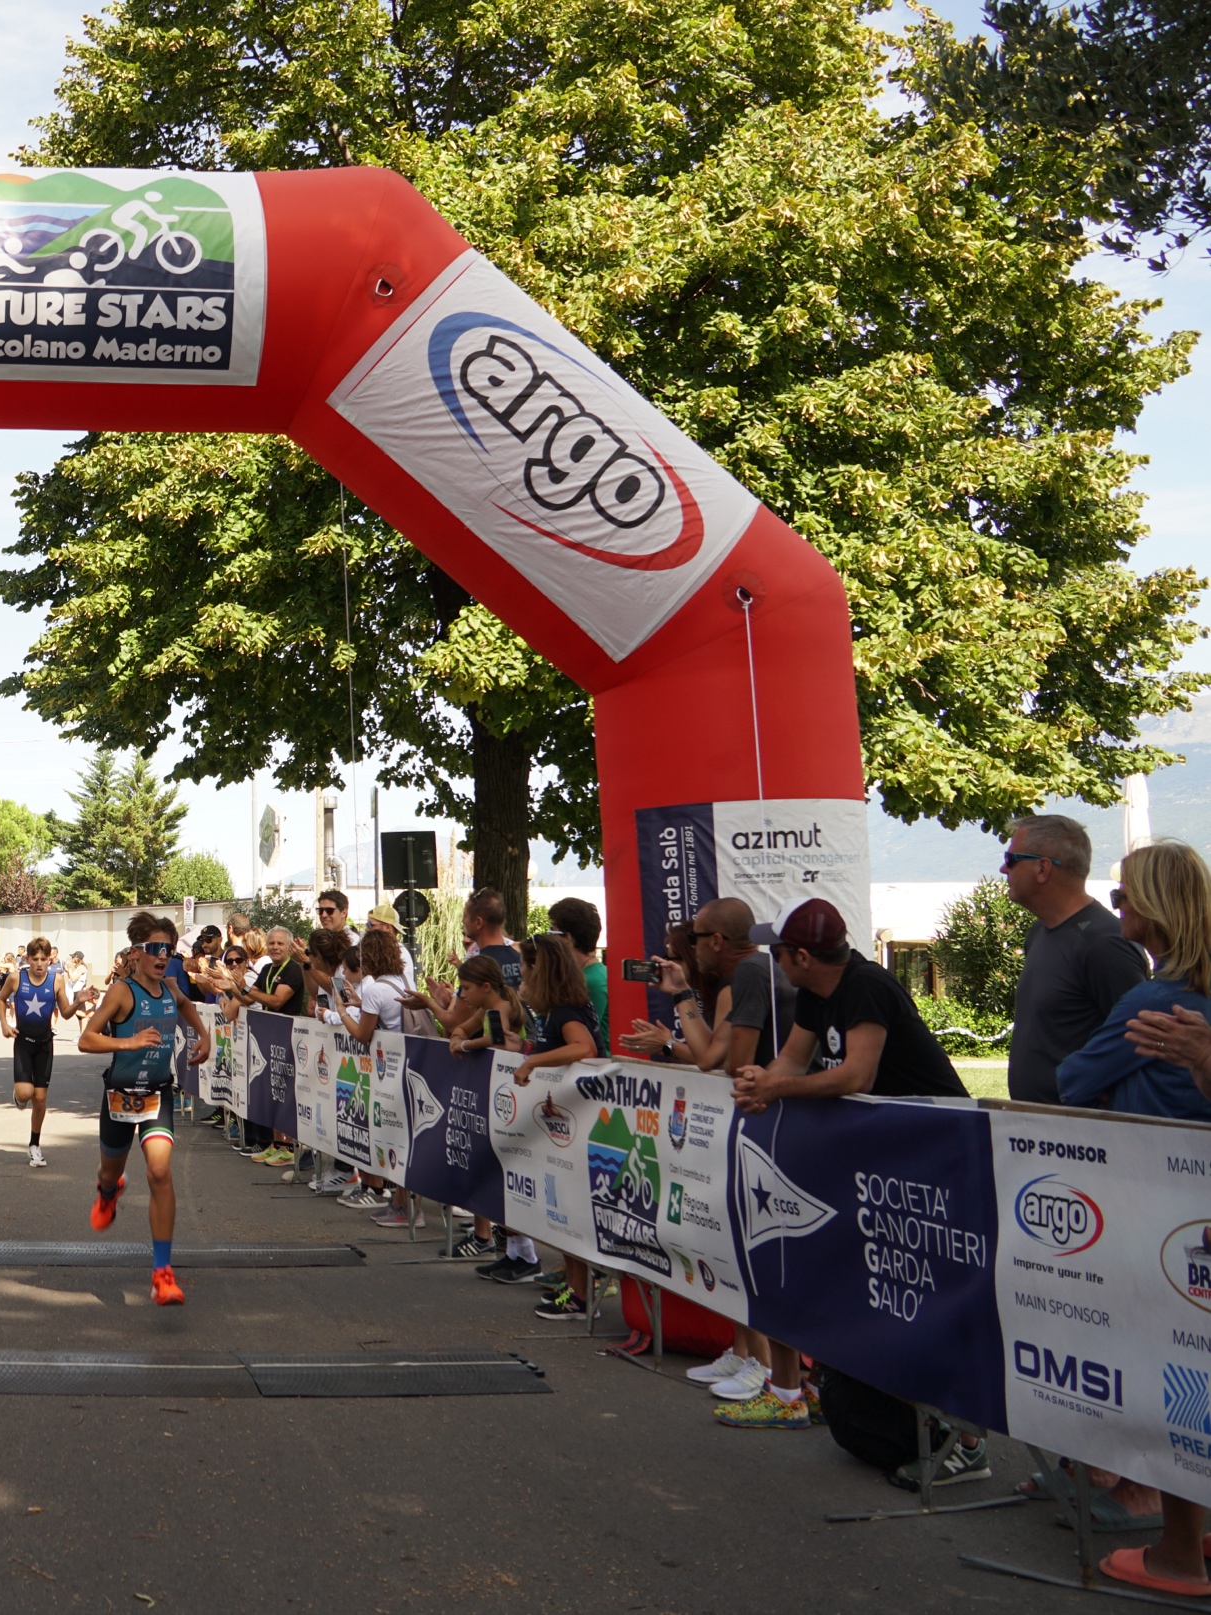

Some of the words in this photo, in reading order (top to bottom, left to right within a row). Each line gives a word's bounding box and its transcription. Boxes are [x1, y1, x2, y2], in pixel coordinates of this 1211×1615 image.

[97, 293, 227, 331] STARS
[93, 335, 222, 364] Maderno
[460, 335, 666, 529] argo
[659, 826, 679, 870] Salò
[684, 825, 694, 848] 1891
[731, 821, 822, 851] azimut
[685, 850, 696, 865] nel
[732, 851, 785, 868] capital
[688, 866, 699, 906] Fondata
[145, 1050, 160, 1059] ITA
[122, 1096, 145, 1113] 89
[575, 1074, 662, 1110] TRIATHLON
[297, 1103, 313, 1121] OMSI
[447, 1107, 487, 1137] CANOTTIERI
[635, 1107, 660, 1137] KIDS
[445, 1127, 473, 1151] GARDA
[1008, 1137, 1035, 1154] TOP
[1038, 1140, 1107, 1164] SPONSOR
[1167, 1156, 1205, 1177] MAIN
[506, 1170, 536, 1199] OMSI
[855, 1171, 949, 1220] SOCIETA'
[683, 1192, 710, 1214] Regione
[774, 1197, 800, 1216] SCGS
[1023, 1191, 1088, 1245] argo
[624, 1219, 660, 1250] STARS
[682, 1207, 721, 1232] Lombardia
[857, 1206, 987, 1268] CANOTTIERI
[864, 1242, 936, 1292] GARDA
[1057, 1267, 1082, 1280] your
[1085, 1271, 1104, 1285] life
[868, 1277, 923, 1322] SALO'
[1015, 1291, 1047, 1312] MAIN
[1049, 1299, 1111, 1328] SPONSOR
[1014, 1339, 1123, 1407] OMSI
[1032, 1388, 1104, 1420] TRASMISSIONI
